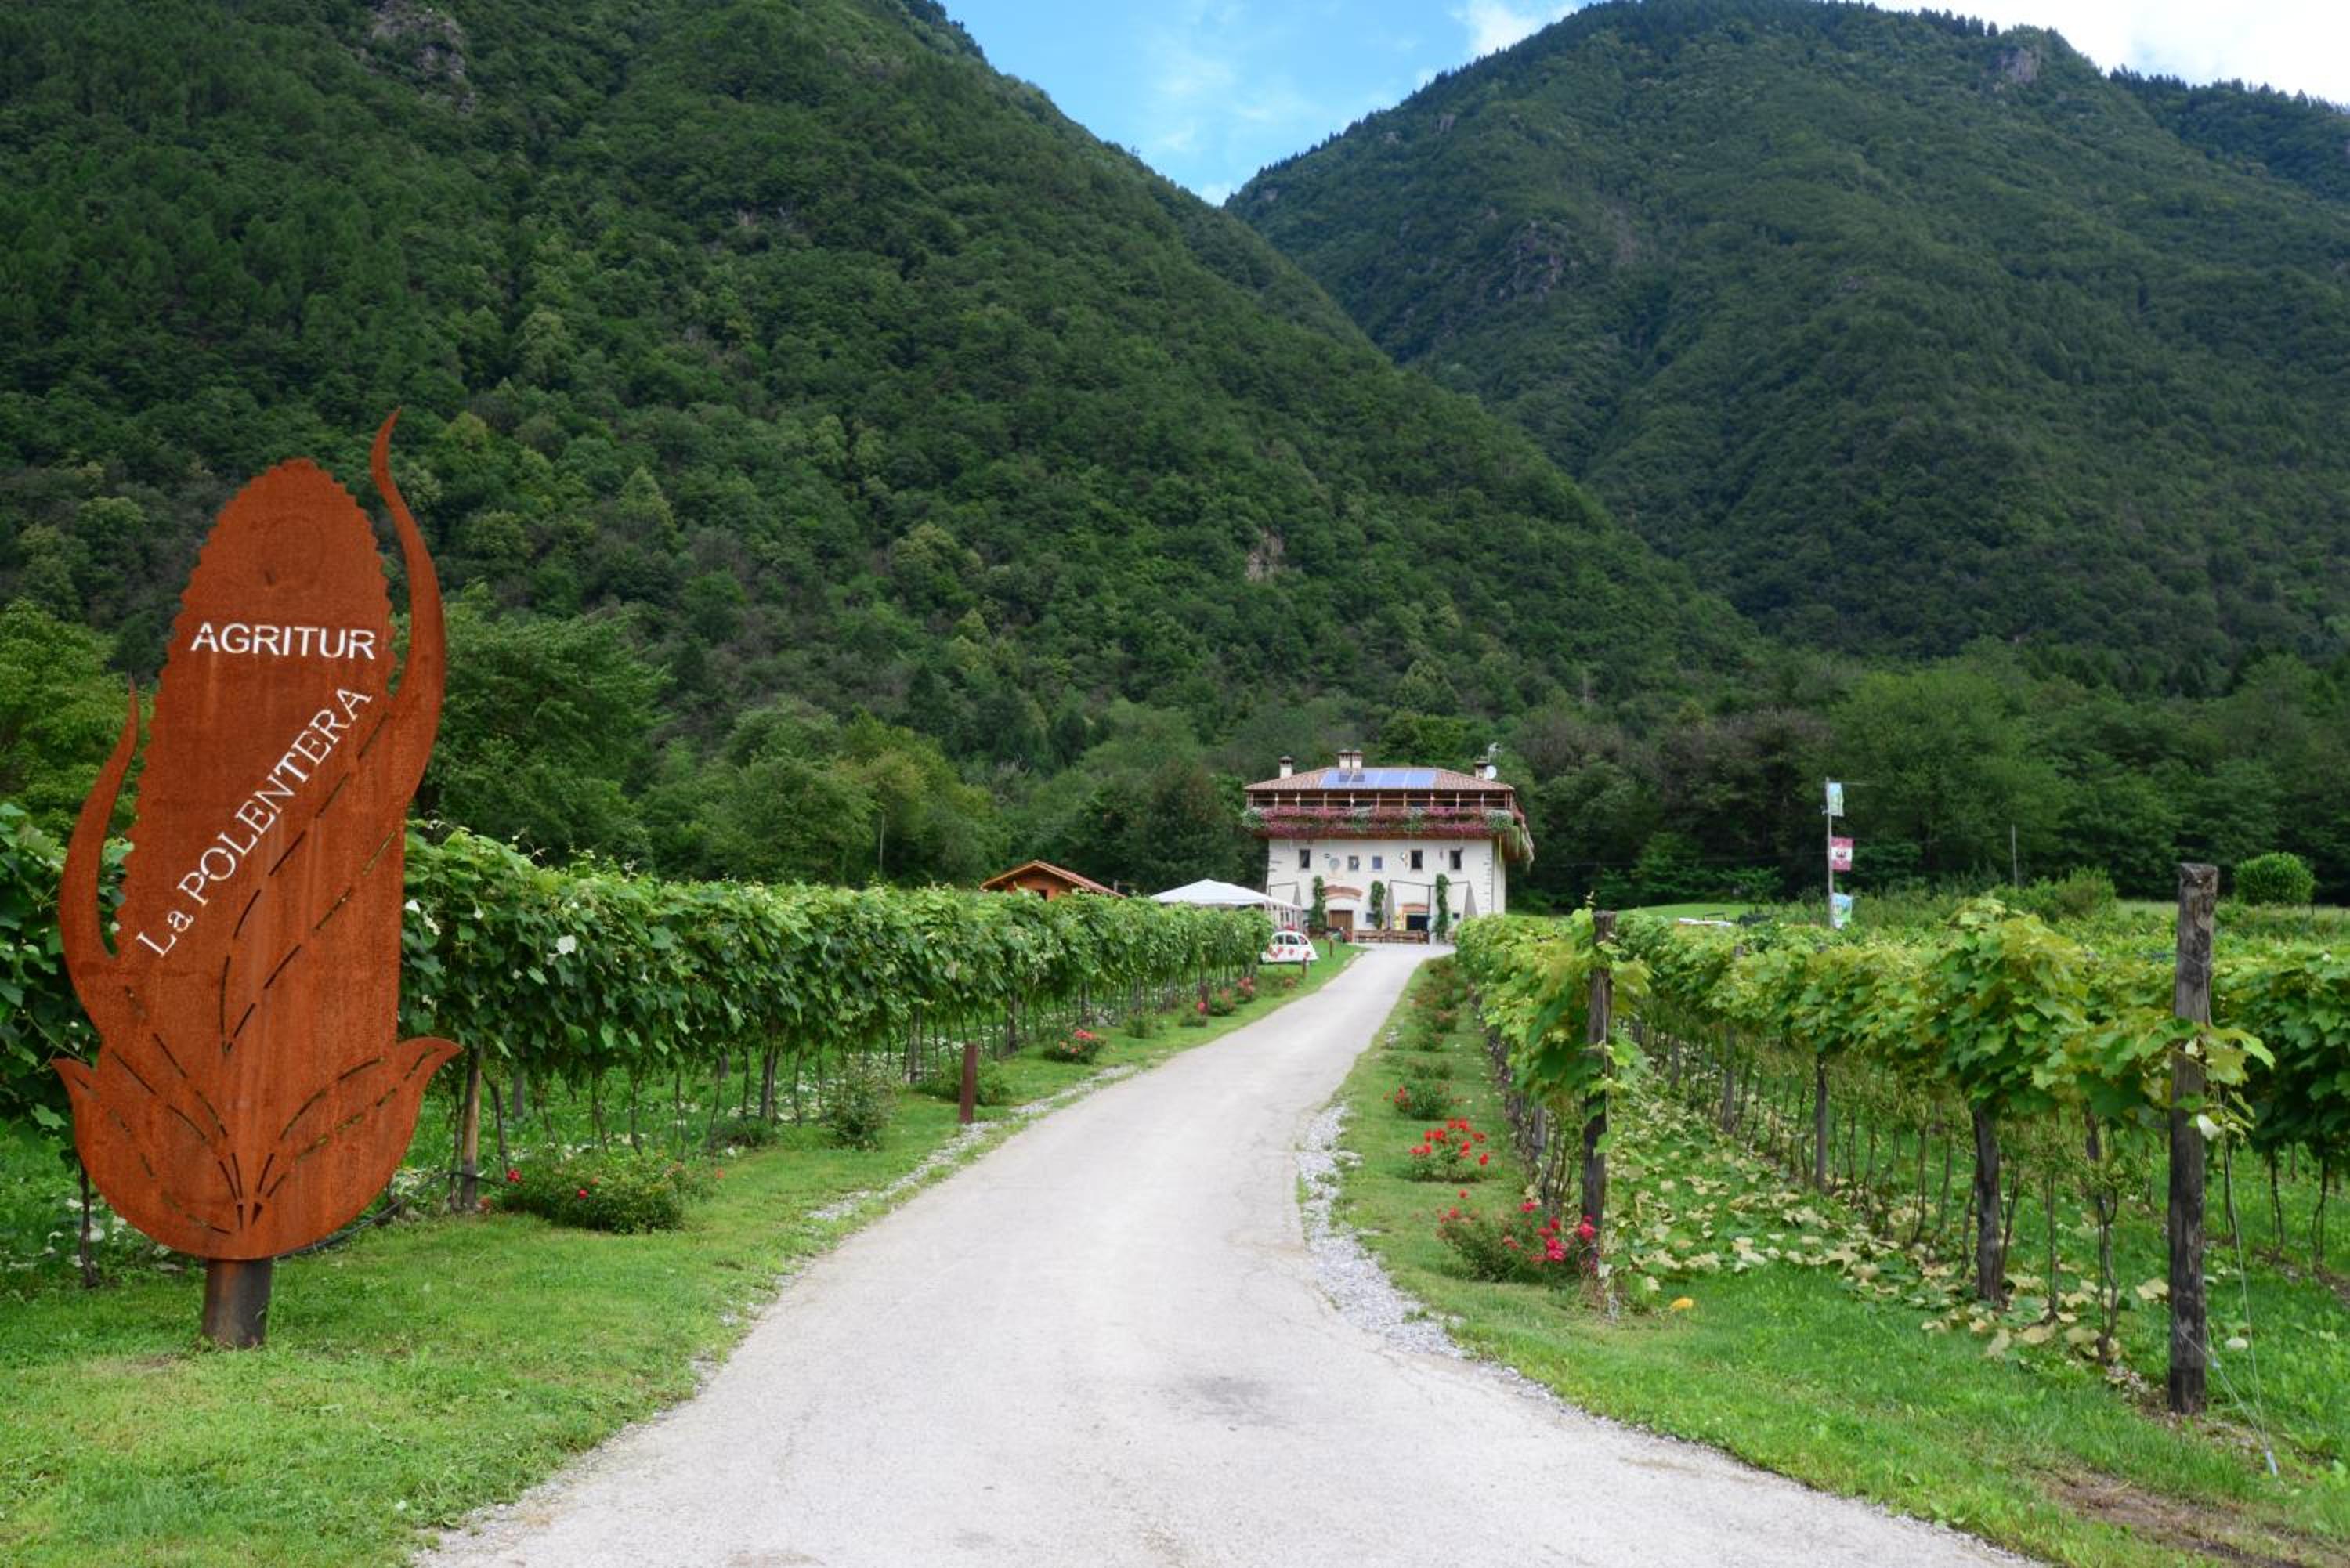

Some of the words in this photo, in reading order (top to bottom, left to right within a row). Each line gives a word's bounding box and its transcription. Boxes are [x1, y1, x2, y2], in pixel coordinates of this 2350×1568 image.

[190, 622, 376, 659] AGRITUR
[136, 907, 194, 957] La
[177, 688, 372, 906] POLENTERA
